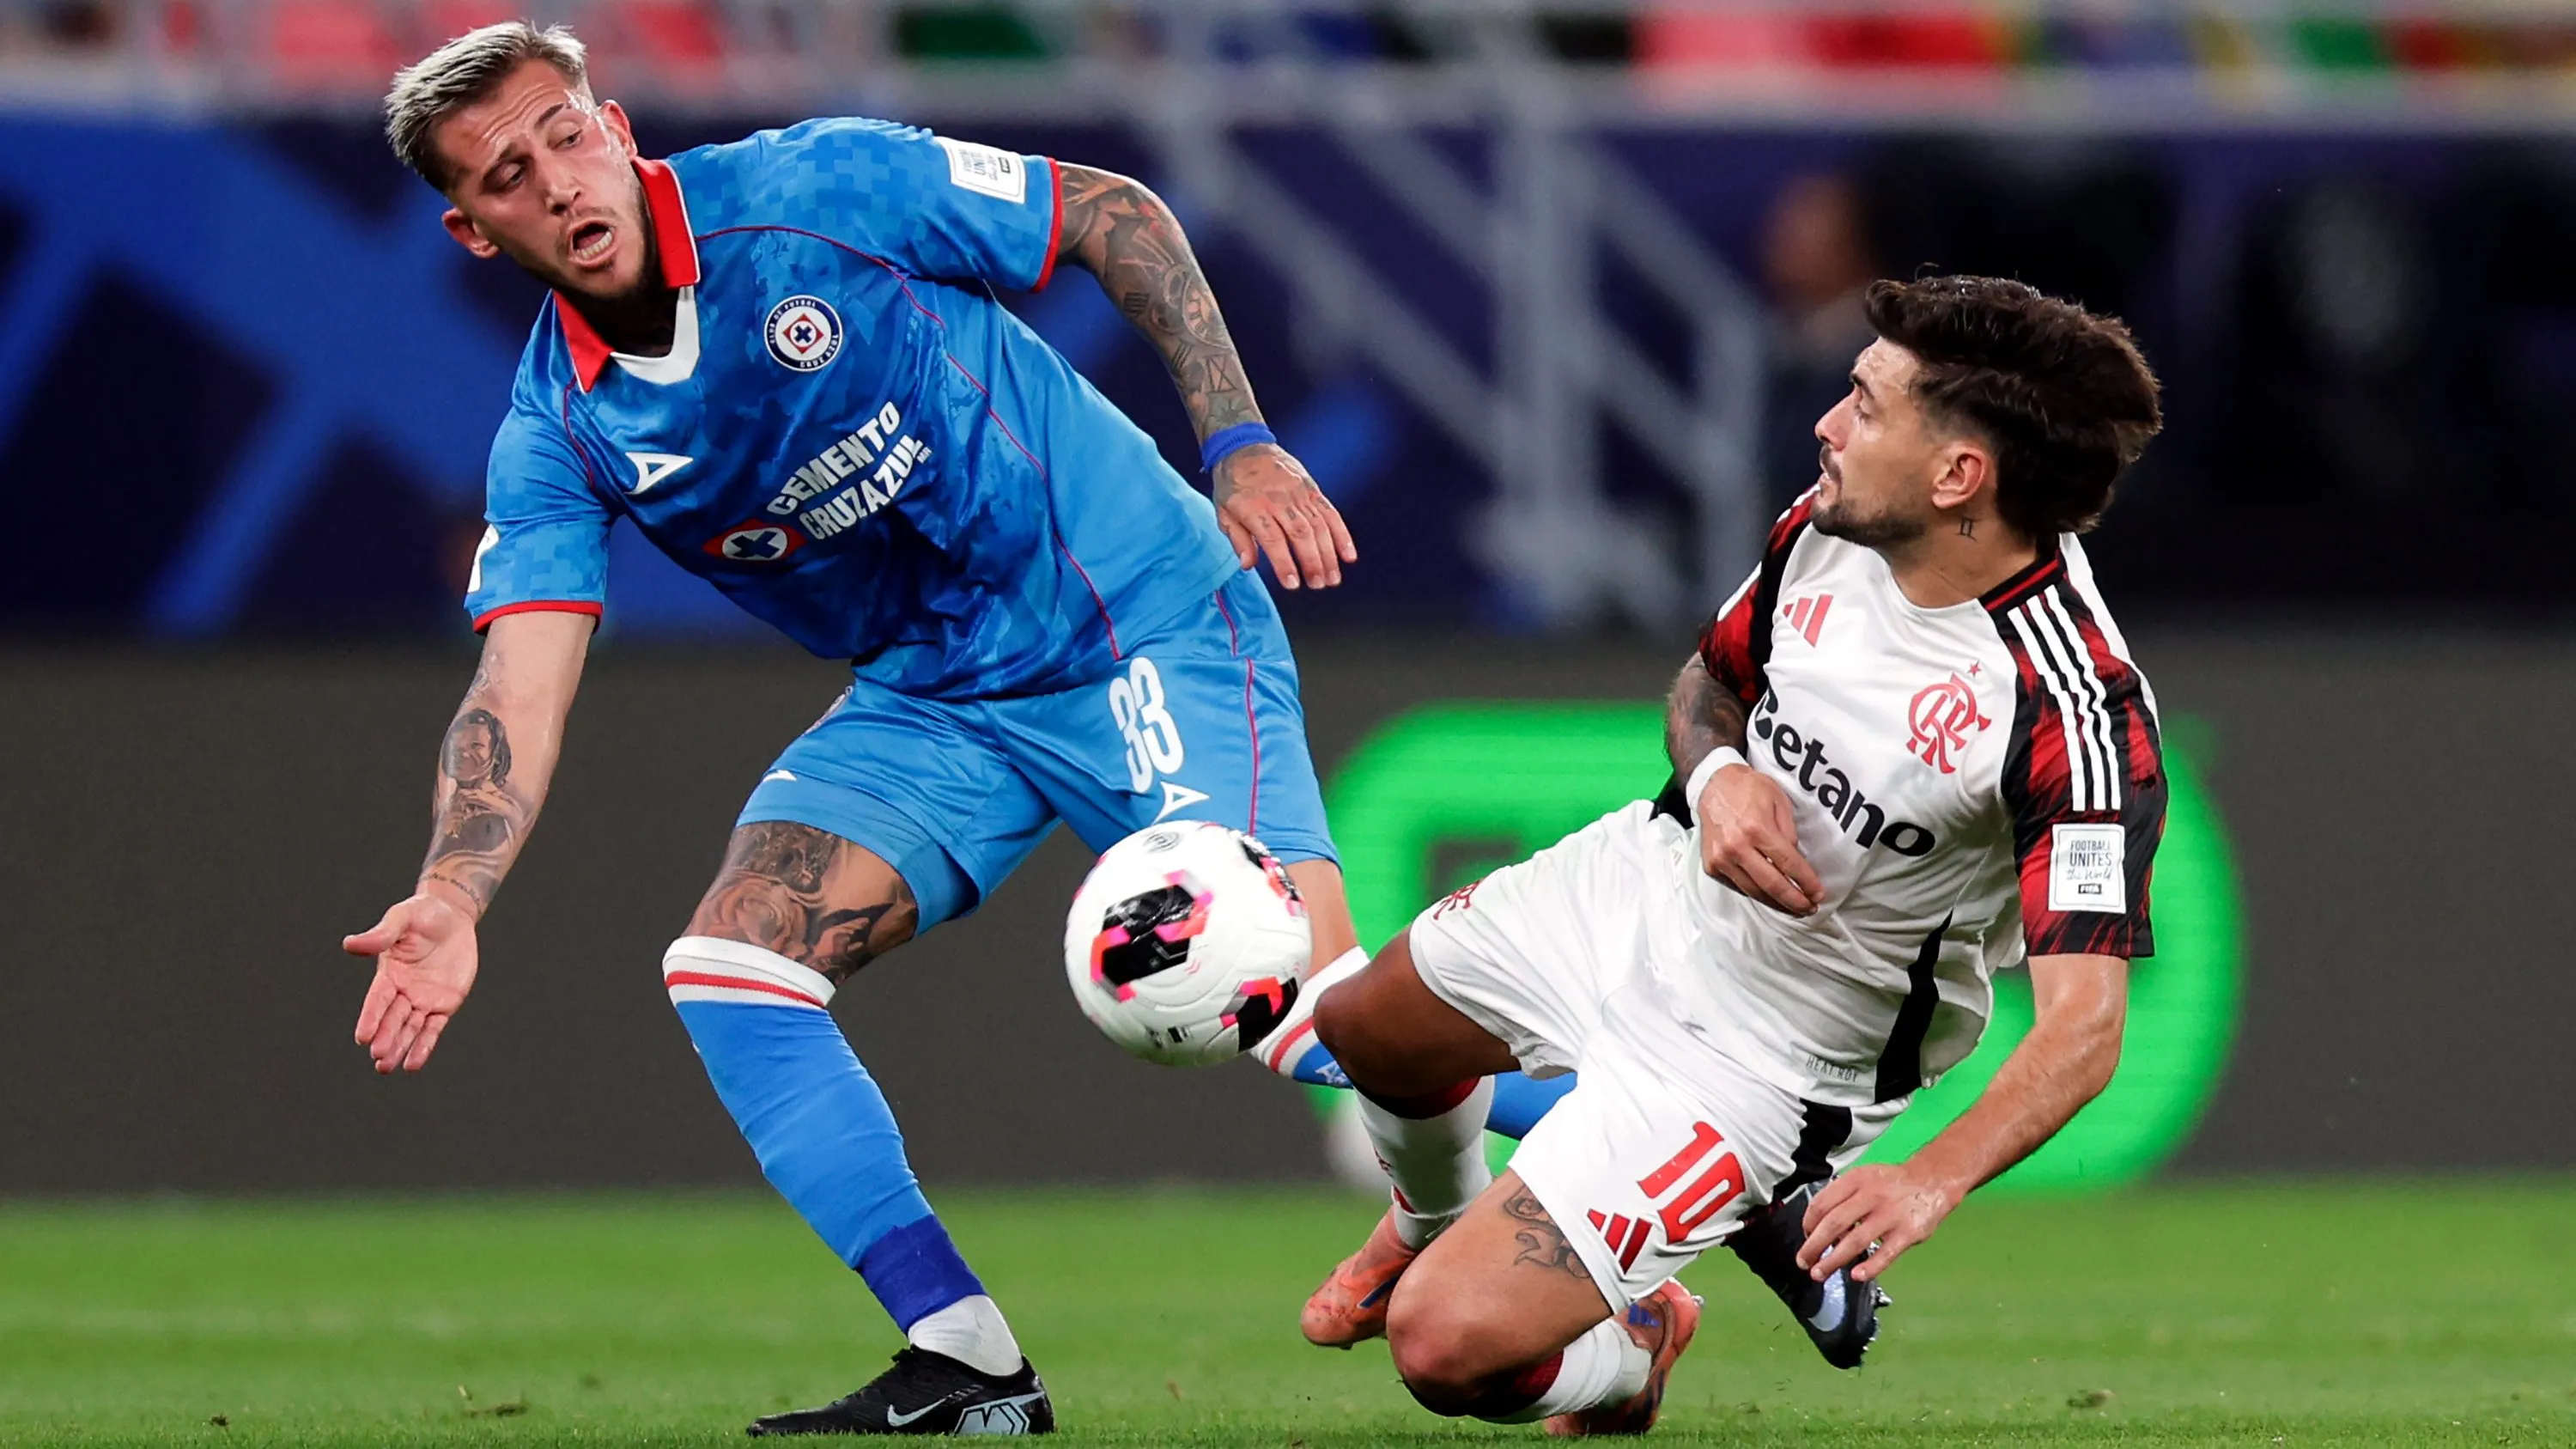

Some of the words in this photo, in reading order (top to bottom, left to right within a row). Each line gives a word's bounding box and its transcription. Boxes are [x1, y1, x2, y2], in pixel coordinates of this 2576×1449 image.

[767, 401, 901, 514] CEMENTO
[1109, 656, 1184, 794] 33
[2069, 852, 2112, 867] UNITES
[2070, 840, 2111, 850] FOOTBALL
[1637, 1120, 1746, 1245] 10
